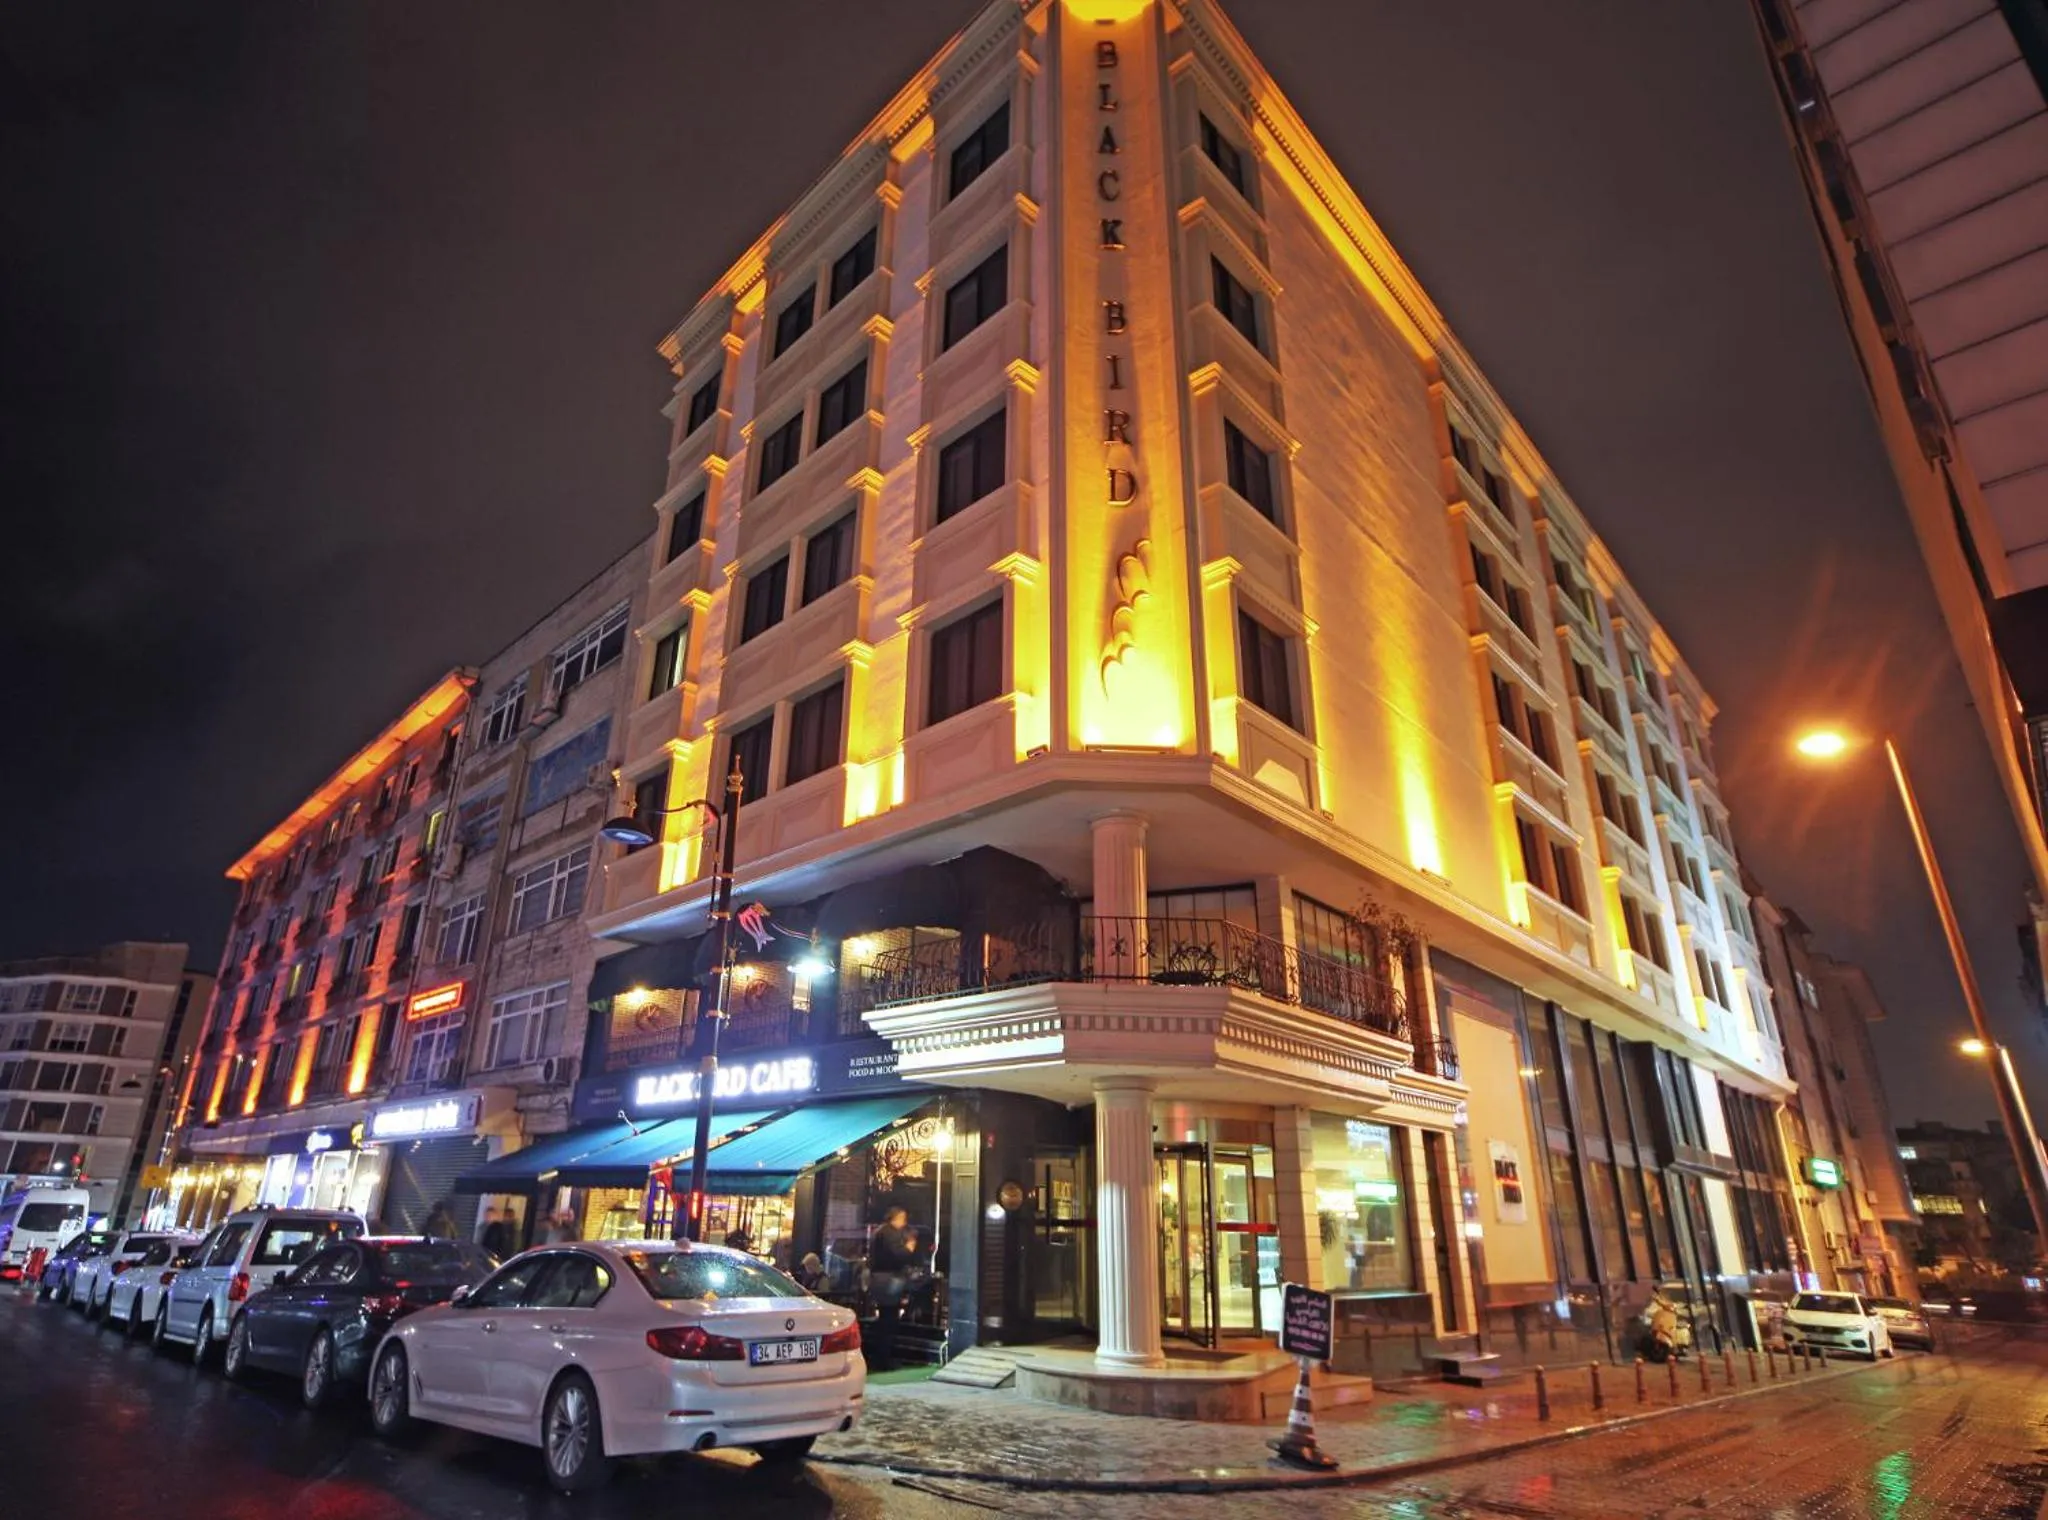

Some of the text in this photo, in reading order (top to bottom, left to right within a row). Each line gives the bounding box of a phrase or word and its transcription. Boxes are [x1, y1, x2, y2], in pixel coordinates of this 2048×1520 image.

[1096, 40, 1138, 506] BLACK BIRD
[636, 1072, 694, 1105] BLACK
[750, 1057, 812, 1093] CAFE
[758, 1341, 815, 1360] 34 AEP 196
